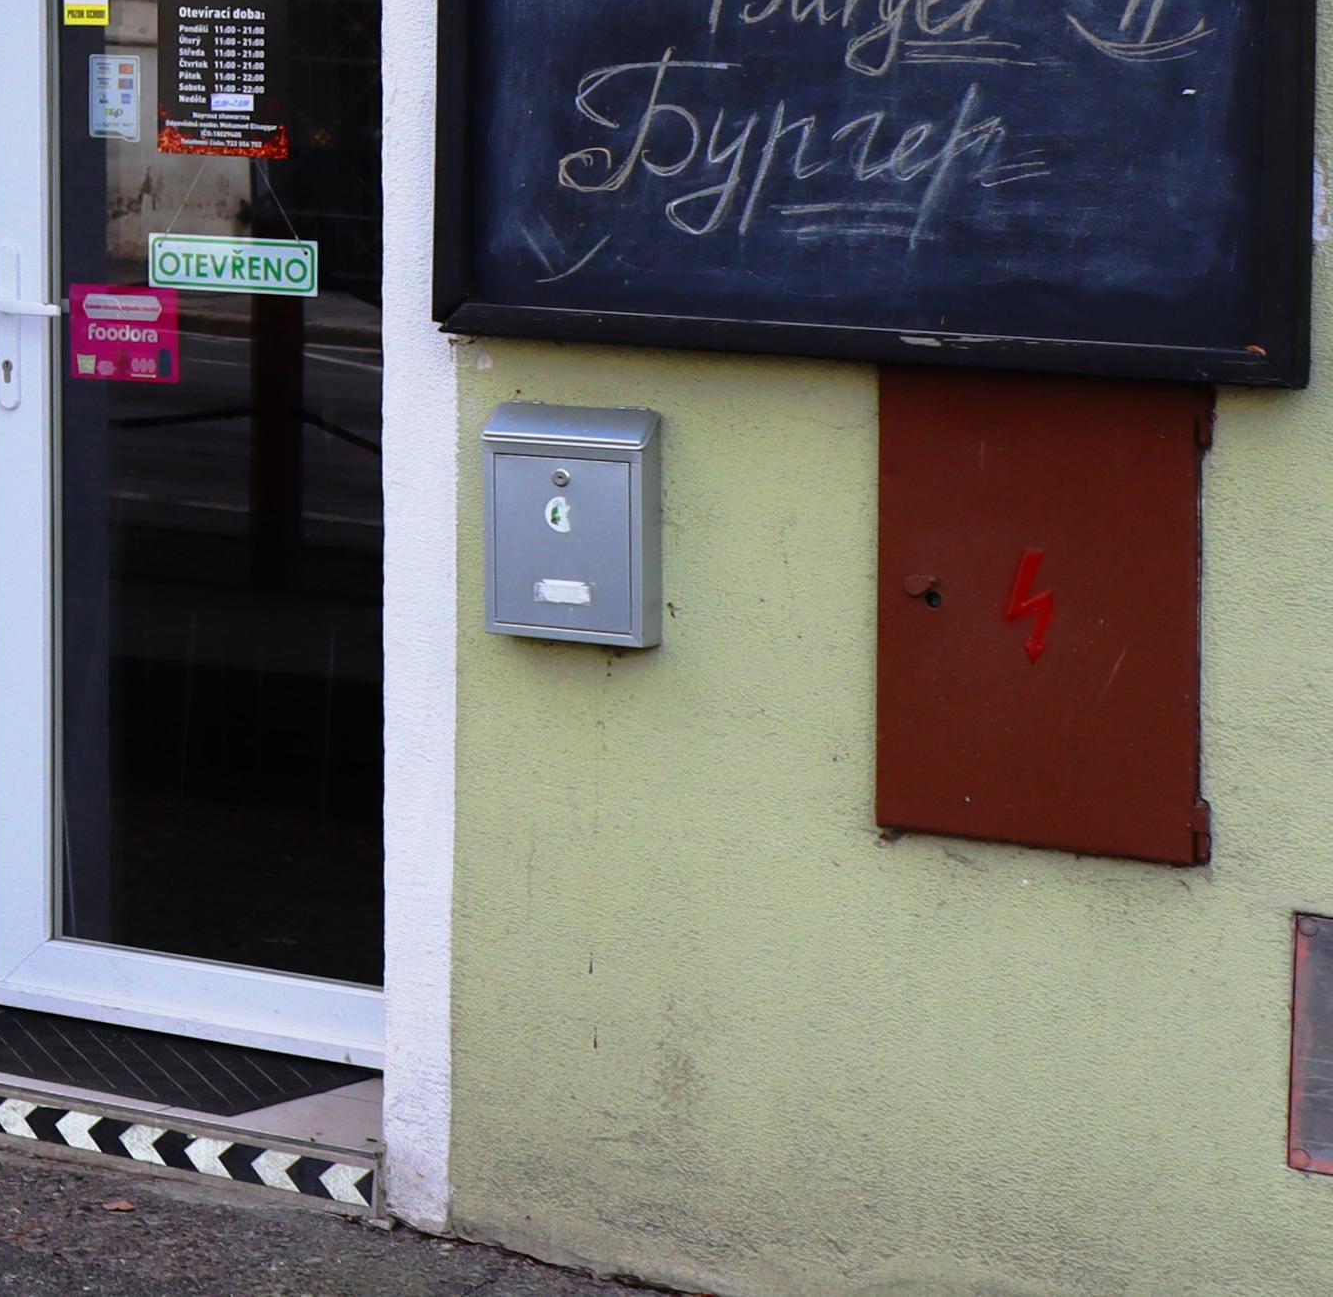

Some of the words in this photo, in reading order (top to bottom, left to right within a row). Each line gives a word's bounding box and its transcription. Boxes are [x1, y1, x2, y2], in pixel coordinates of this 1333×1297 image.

[178, 6, 231, 19] Otevírací
[233, 7, 266, 20] doba:
[558, 46, 1013, 250] Бургер
[158, 249, 308, 284] OTEVŘENO
[88, 322, 159, 344] foodora
